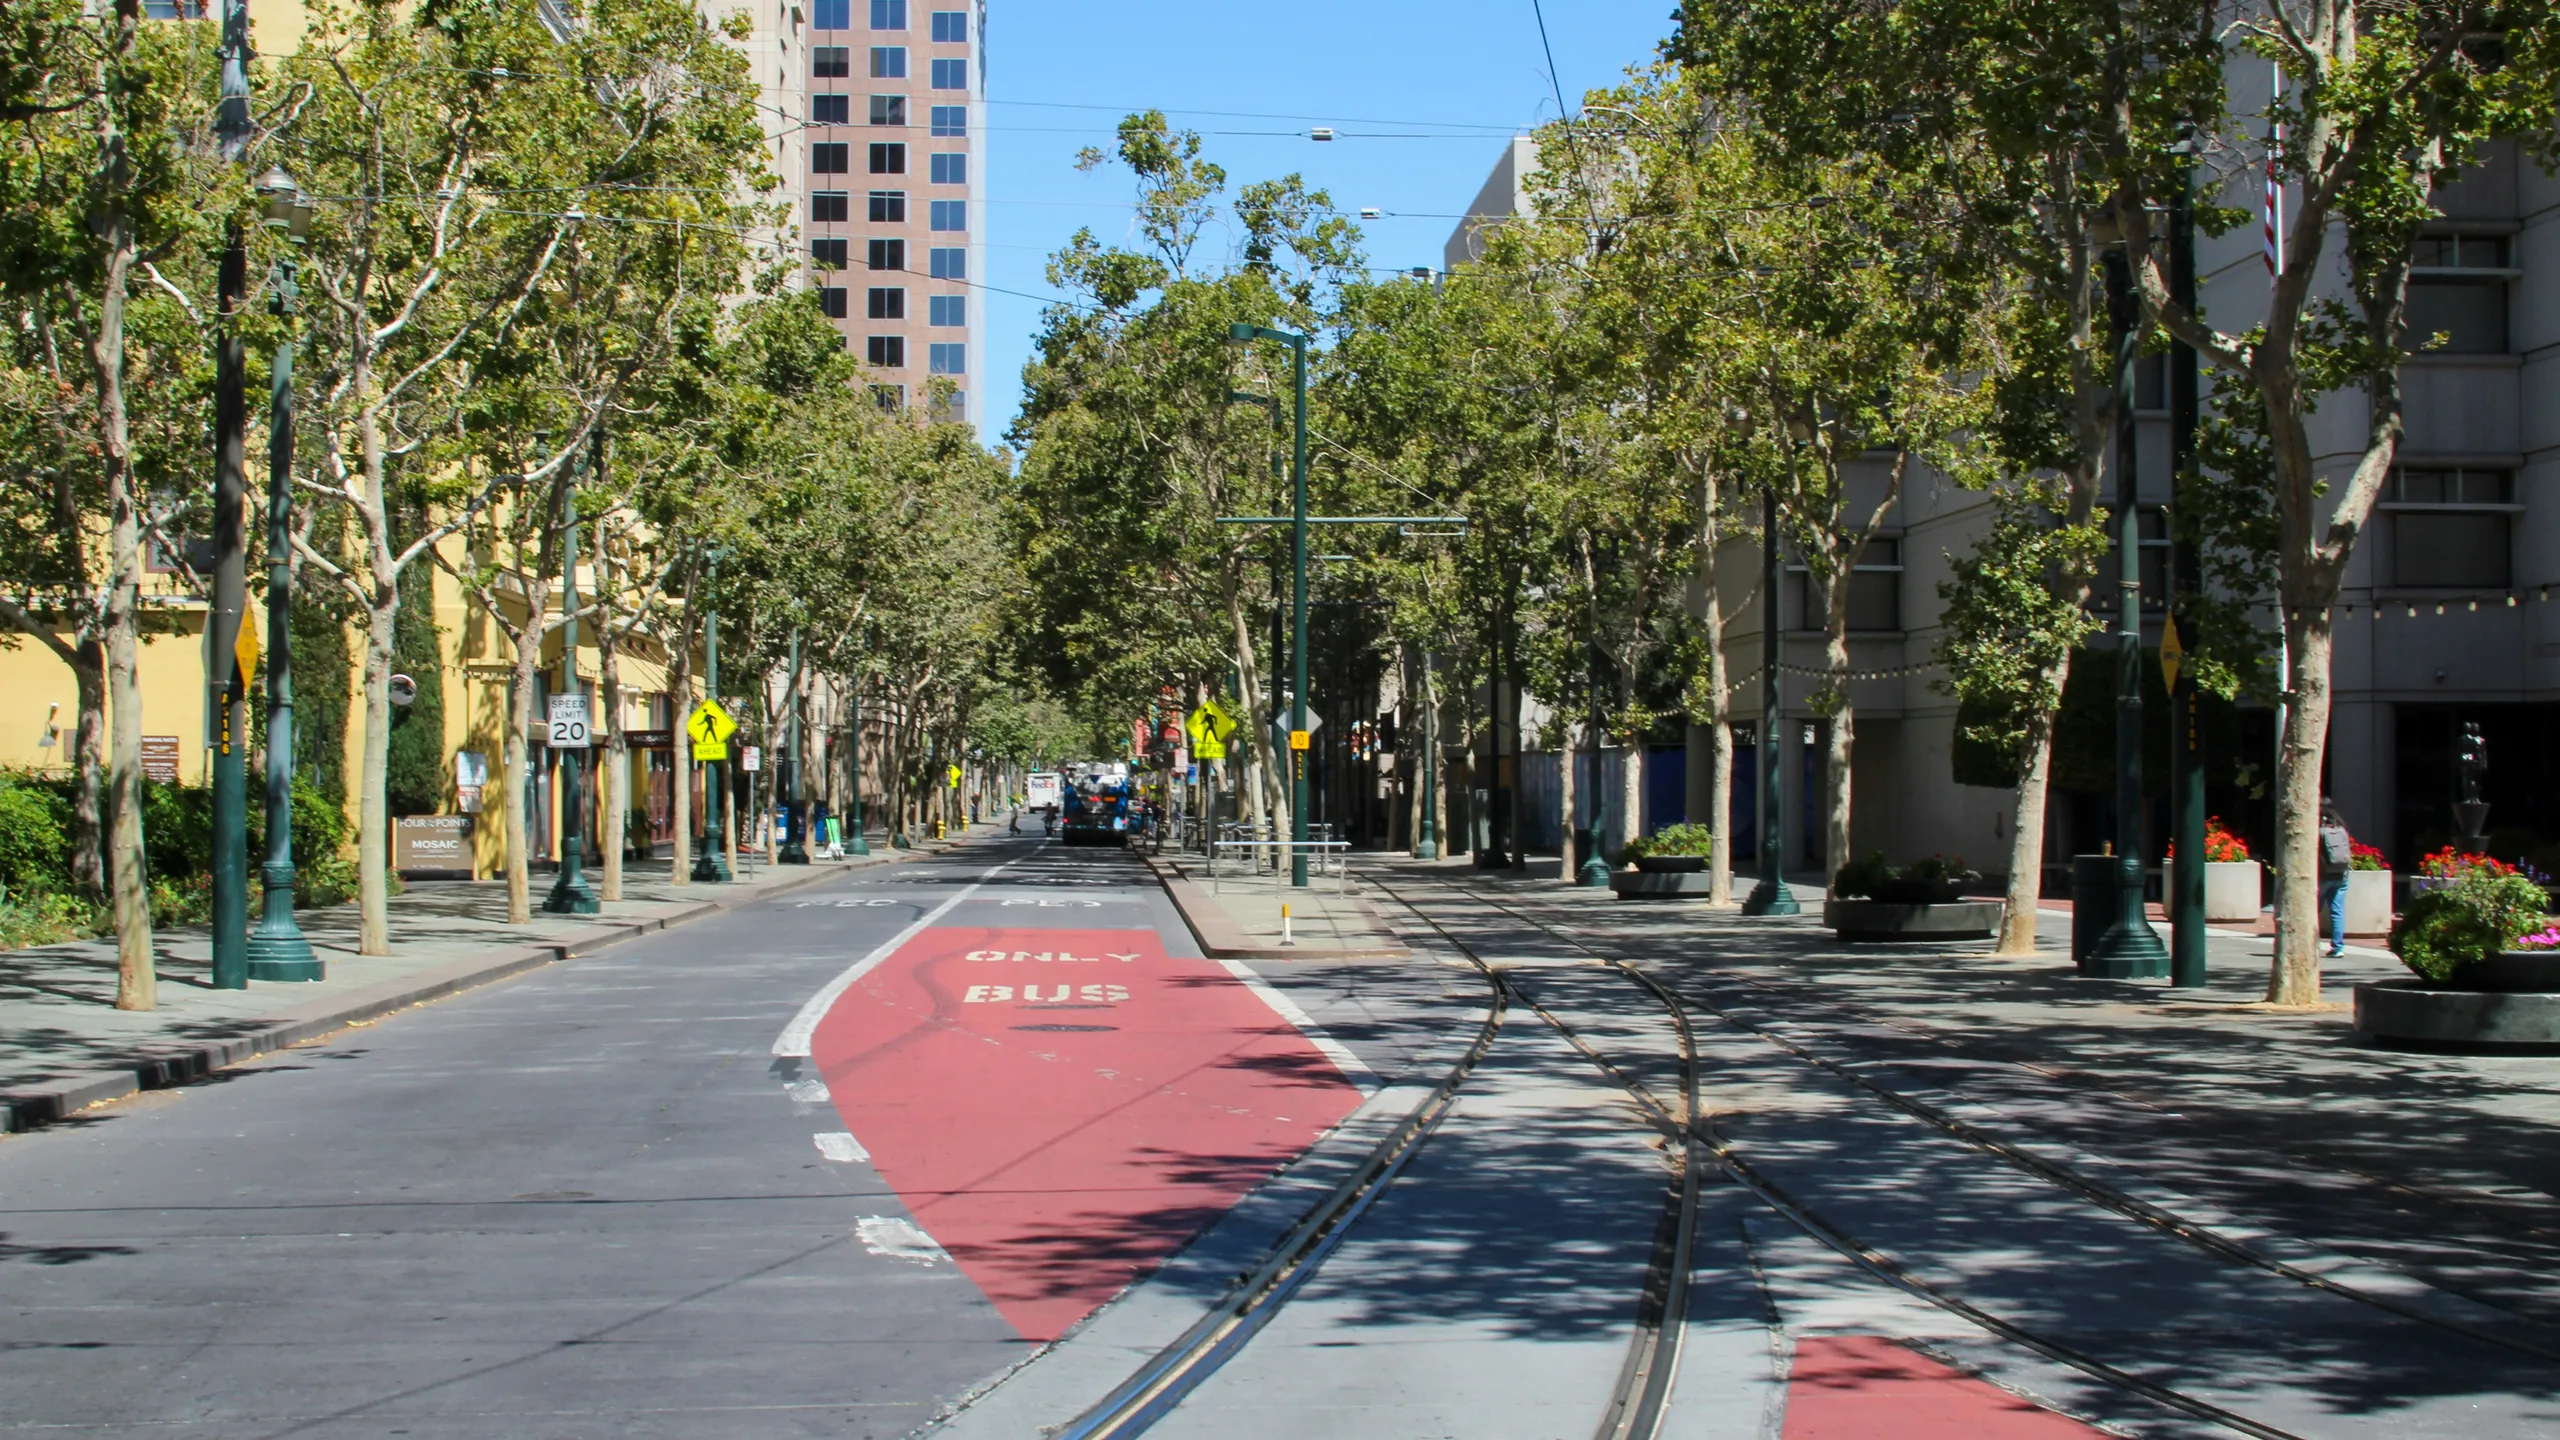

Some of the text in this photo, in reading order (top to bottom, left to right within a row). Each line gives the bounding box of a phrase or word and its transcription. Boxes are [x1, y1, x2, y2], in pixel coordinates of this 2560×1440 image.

[552, 700, 586, 708] SPEED
[555, 711, 582, 719] LIMIT
[554, 722, 585, 740] 20
[1031, 781, 1056, 789] FedEx
[436, 819, 471, 828] POINTS
[412, 840, 459, 849] MOSAIC
[965, 950, 1142, 962] ONLY
[963, 984, 1131, 1003] BUS
